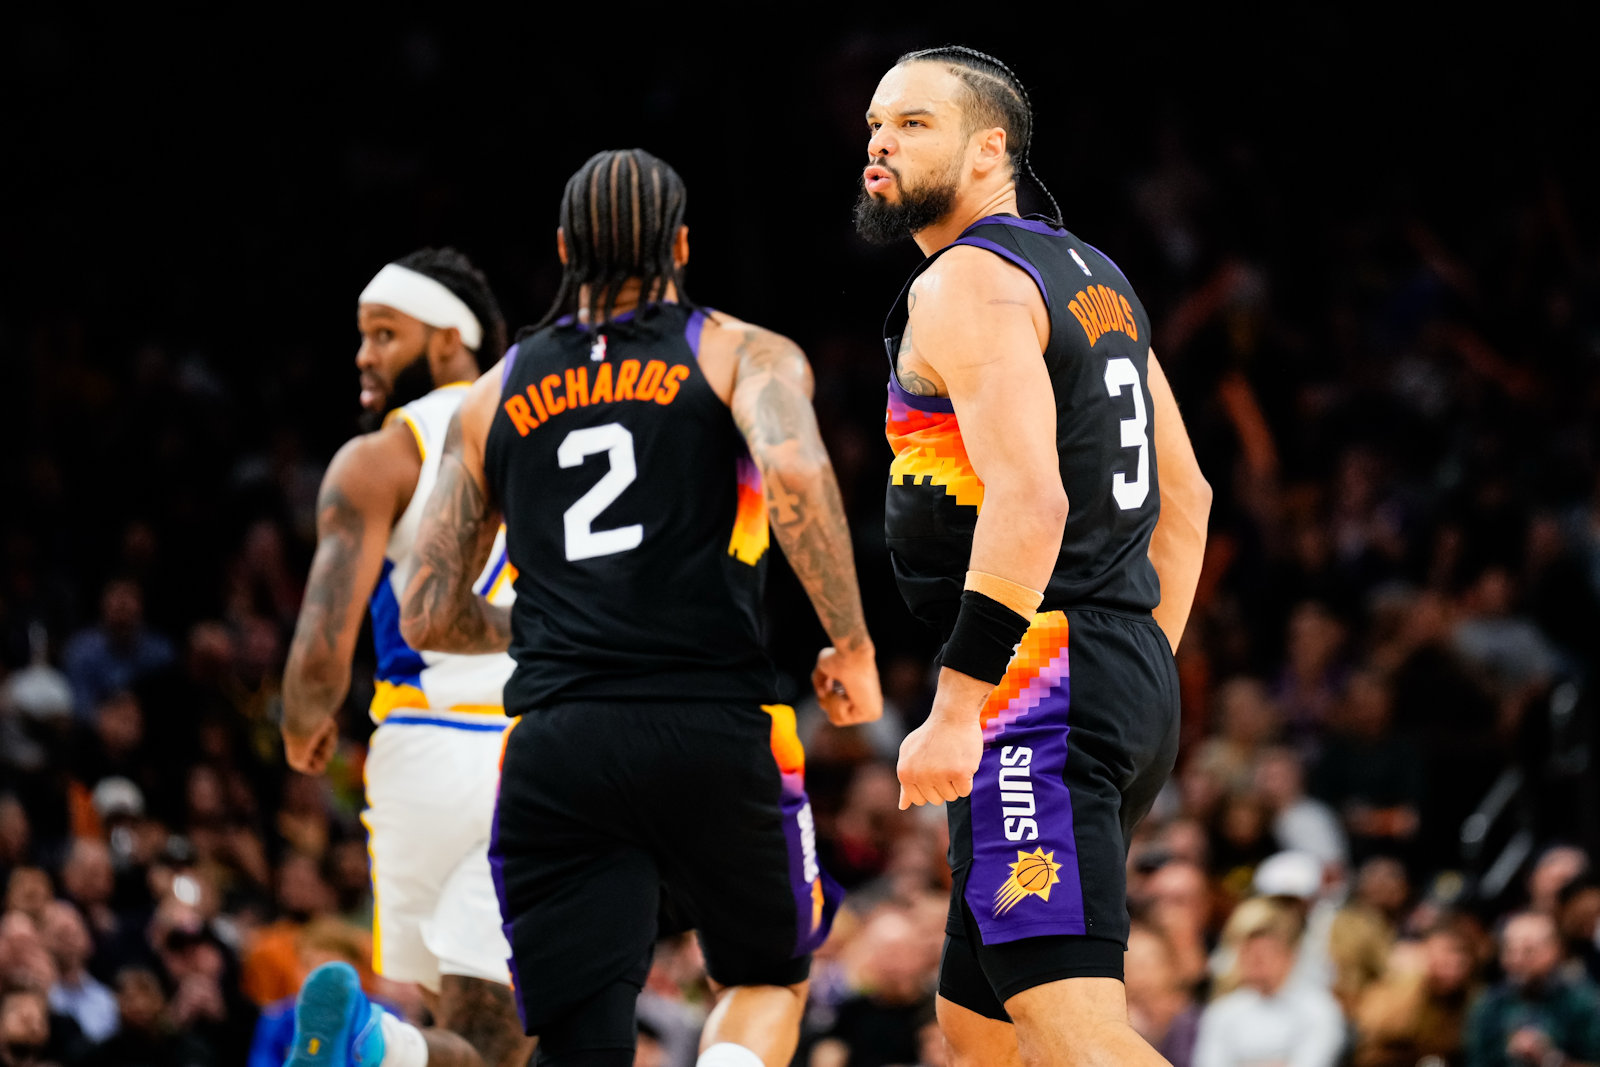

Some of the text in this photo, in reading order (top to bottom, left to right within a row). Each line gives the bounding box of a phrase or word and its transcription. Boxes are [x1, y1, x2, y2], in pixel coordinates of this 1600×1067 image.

[1067, 284, 1138, 348] BROOKS
[504, 359, 690, 437] RICHARDS
[1104, 357, 1149, 511] 3
[557, 422, 643, 562] 2
[999, 745, 1039, 841] SUNS
